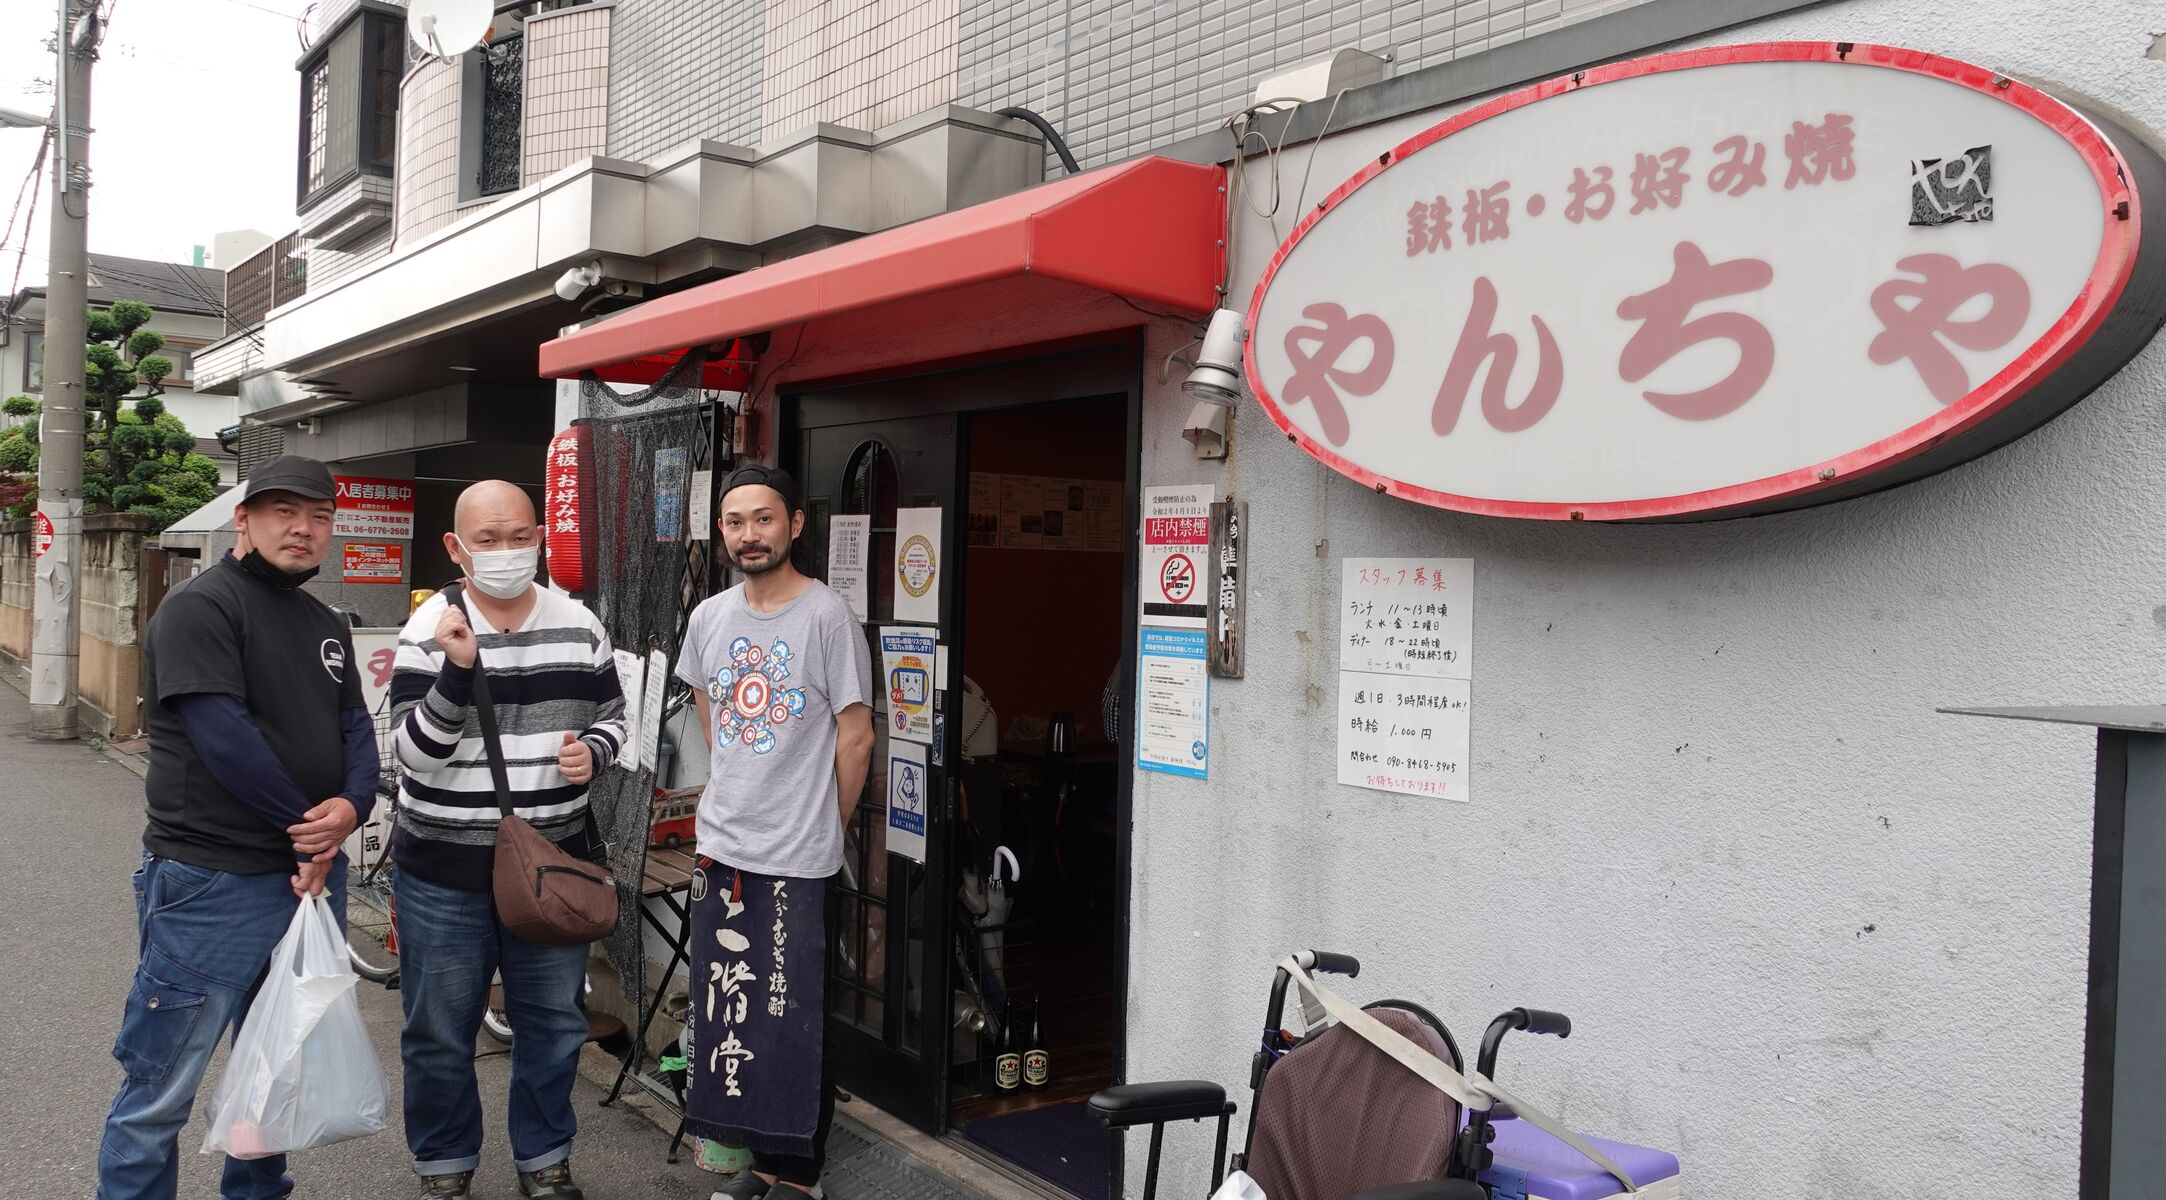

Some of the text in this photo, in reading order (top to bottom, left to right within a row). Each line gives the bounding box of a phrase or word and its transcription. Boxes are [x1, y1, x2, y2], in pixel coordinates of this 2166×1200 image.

[1405, 113, 1856, 258] 鉄板・お好み焼
[336, 482, 411, 501] 入居者募集中
[556, 437, 580, 534] 鉄板・お好み焼
[1152, 494, 1197, 505] 受動喫煙防止の為
[336, 524, 352, 533] TEL
[1151, 518, 1207, 538] 店内禁煙
[1359, 566, 1447, 592] スタッフ募集
[1350, 600, 1374, 616] ランチ
[1350, 633, 1371, 648] ディナー
[1351, 717, 1379, 734] 時給
[1350, 750, 1457, 774] 問合わせ 090-8468-5905
[767, 879, 788, 1018] 大分むぎ焼酎
